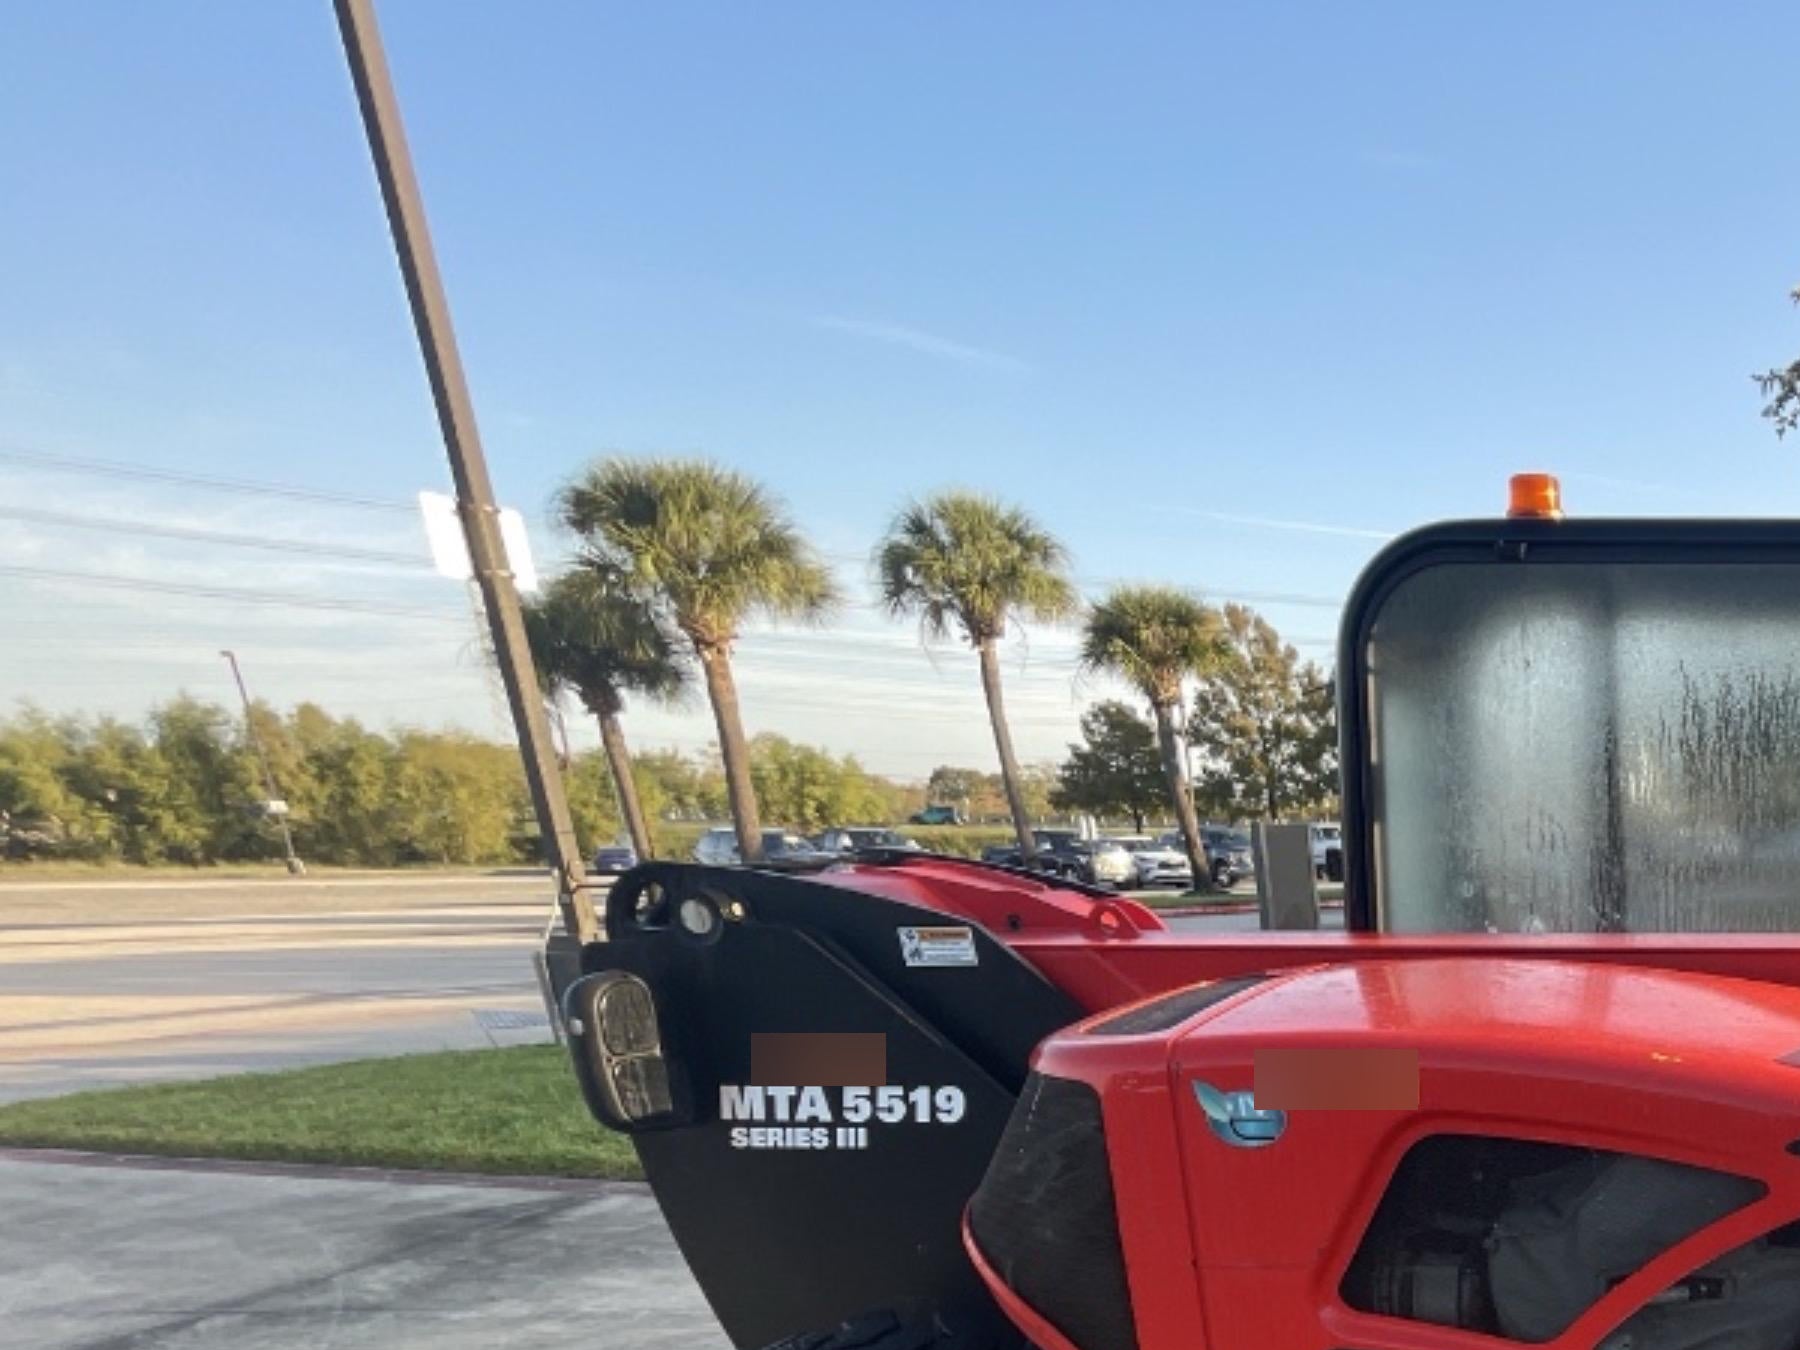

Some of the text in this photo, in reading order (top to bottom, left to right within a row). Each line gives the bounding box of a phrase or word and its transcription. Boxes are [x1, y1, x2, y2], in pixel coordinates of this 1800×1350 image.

[719, 1084, 966, 1123] MTA 5519
[730, 1126, 868, 1149] SERIES III
